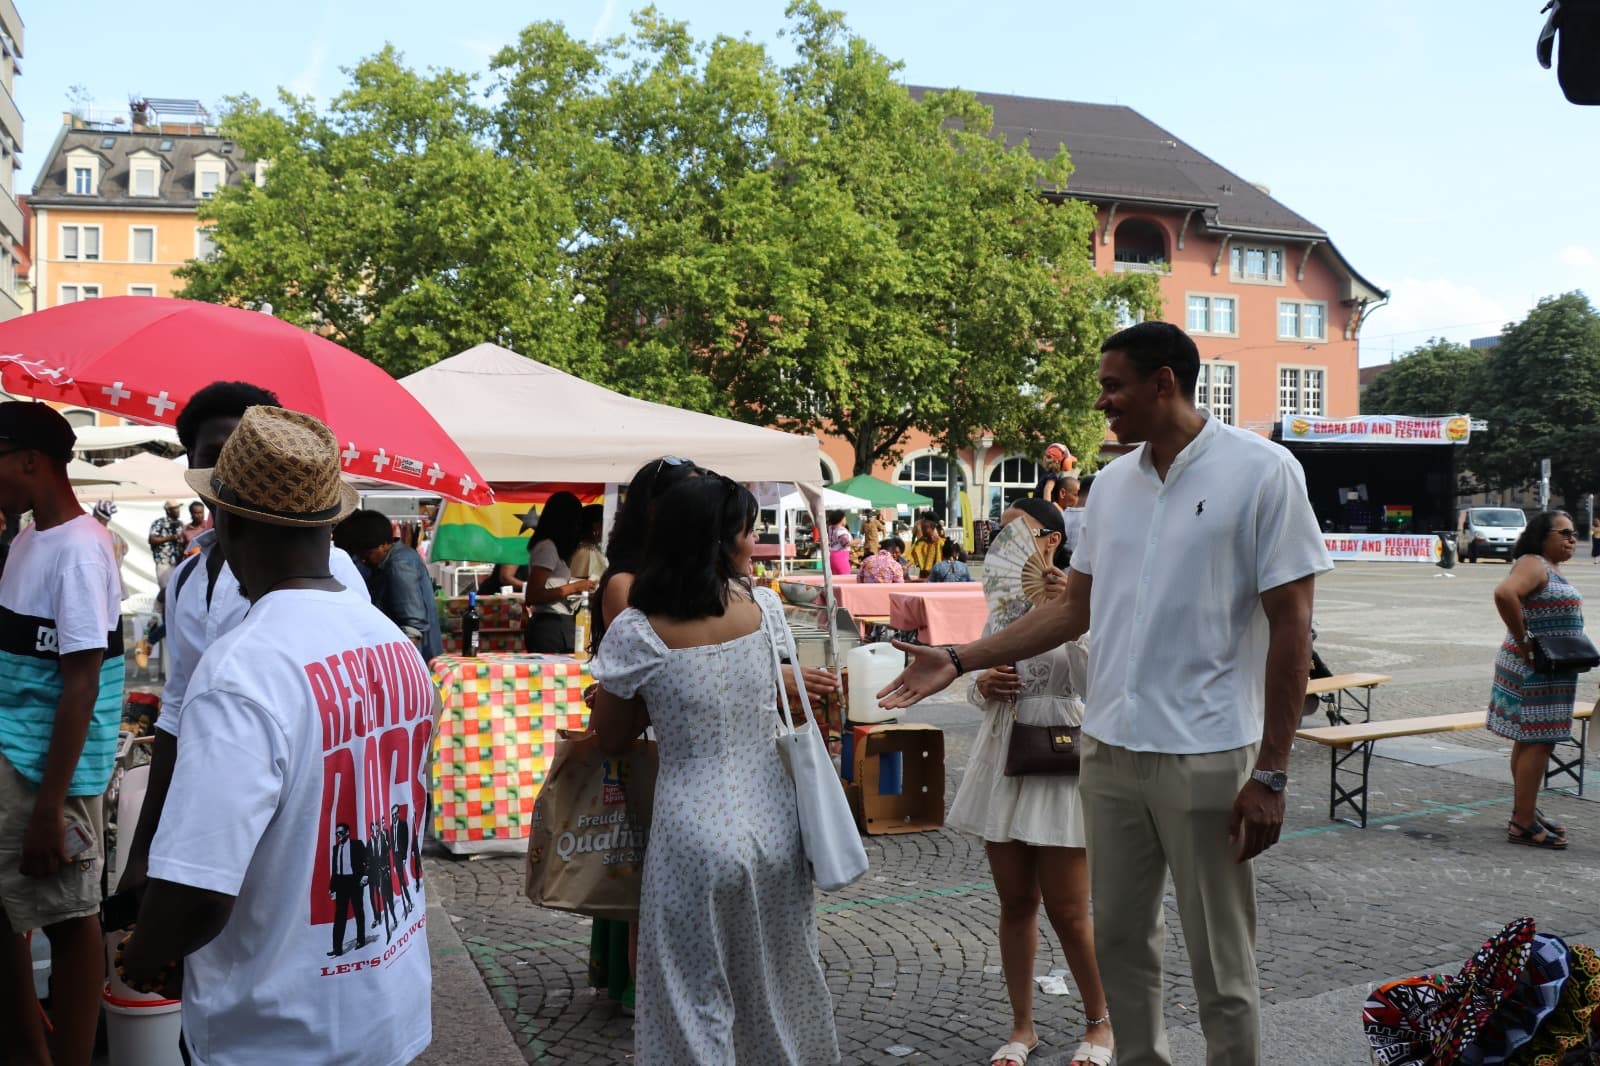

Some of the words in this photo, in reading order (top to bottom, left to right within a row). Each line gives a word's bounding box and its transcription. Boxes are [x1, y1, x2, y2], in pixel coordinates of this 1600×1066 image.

[1314, 421, 1348, 434] GHANA
[1350, 422, 1369, 435] DAY
[1371, 422, 1392, 435] AND
[1395, 419, 1441, 430] HIGHLIFE
[1395, 429, 1442, 439] FESTIVAL
[1340, 539, 1358, 552] DAY
[1361, 539, 1382, 553] AND
[1385, 537, 1431, 547] HIGHLIFE
[1384, 546, 1431, 557] FESTIVAL
[577, 811, 625, 827] Freude
[603, 853, 625, 865] Seit
[320, 957, 381, 976] LET'S
[383, 944, 396, 960] GO
[397, 932, 409, 948] TO
